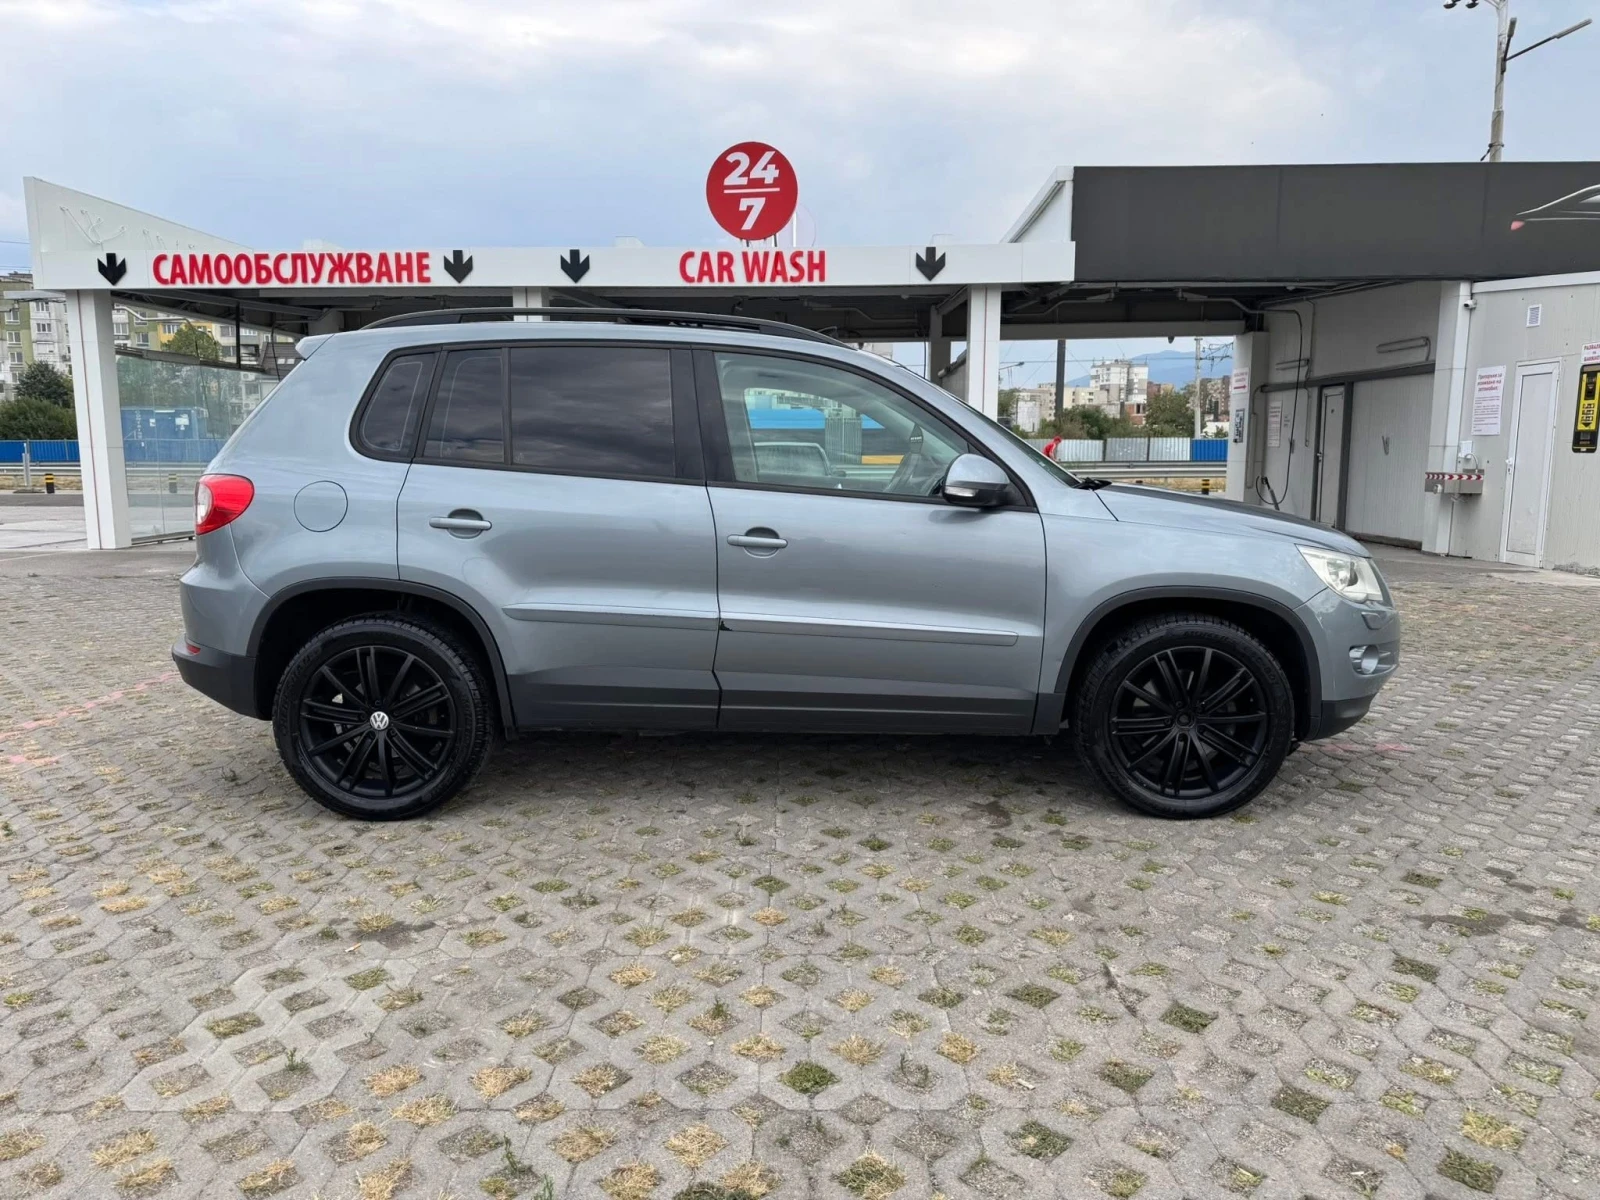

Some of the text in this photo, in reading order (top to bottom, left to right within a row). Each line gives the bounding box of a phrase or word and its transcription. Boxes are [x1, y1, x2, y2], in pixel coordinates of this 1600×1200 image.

[723, 150, 780, 186] 24
[738, 197, 766, 231] 7
[152, 252, 431, 285] САМООБСЛУЖВАНЕ
[679, 250, 826, 284] CAR WASH
